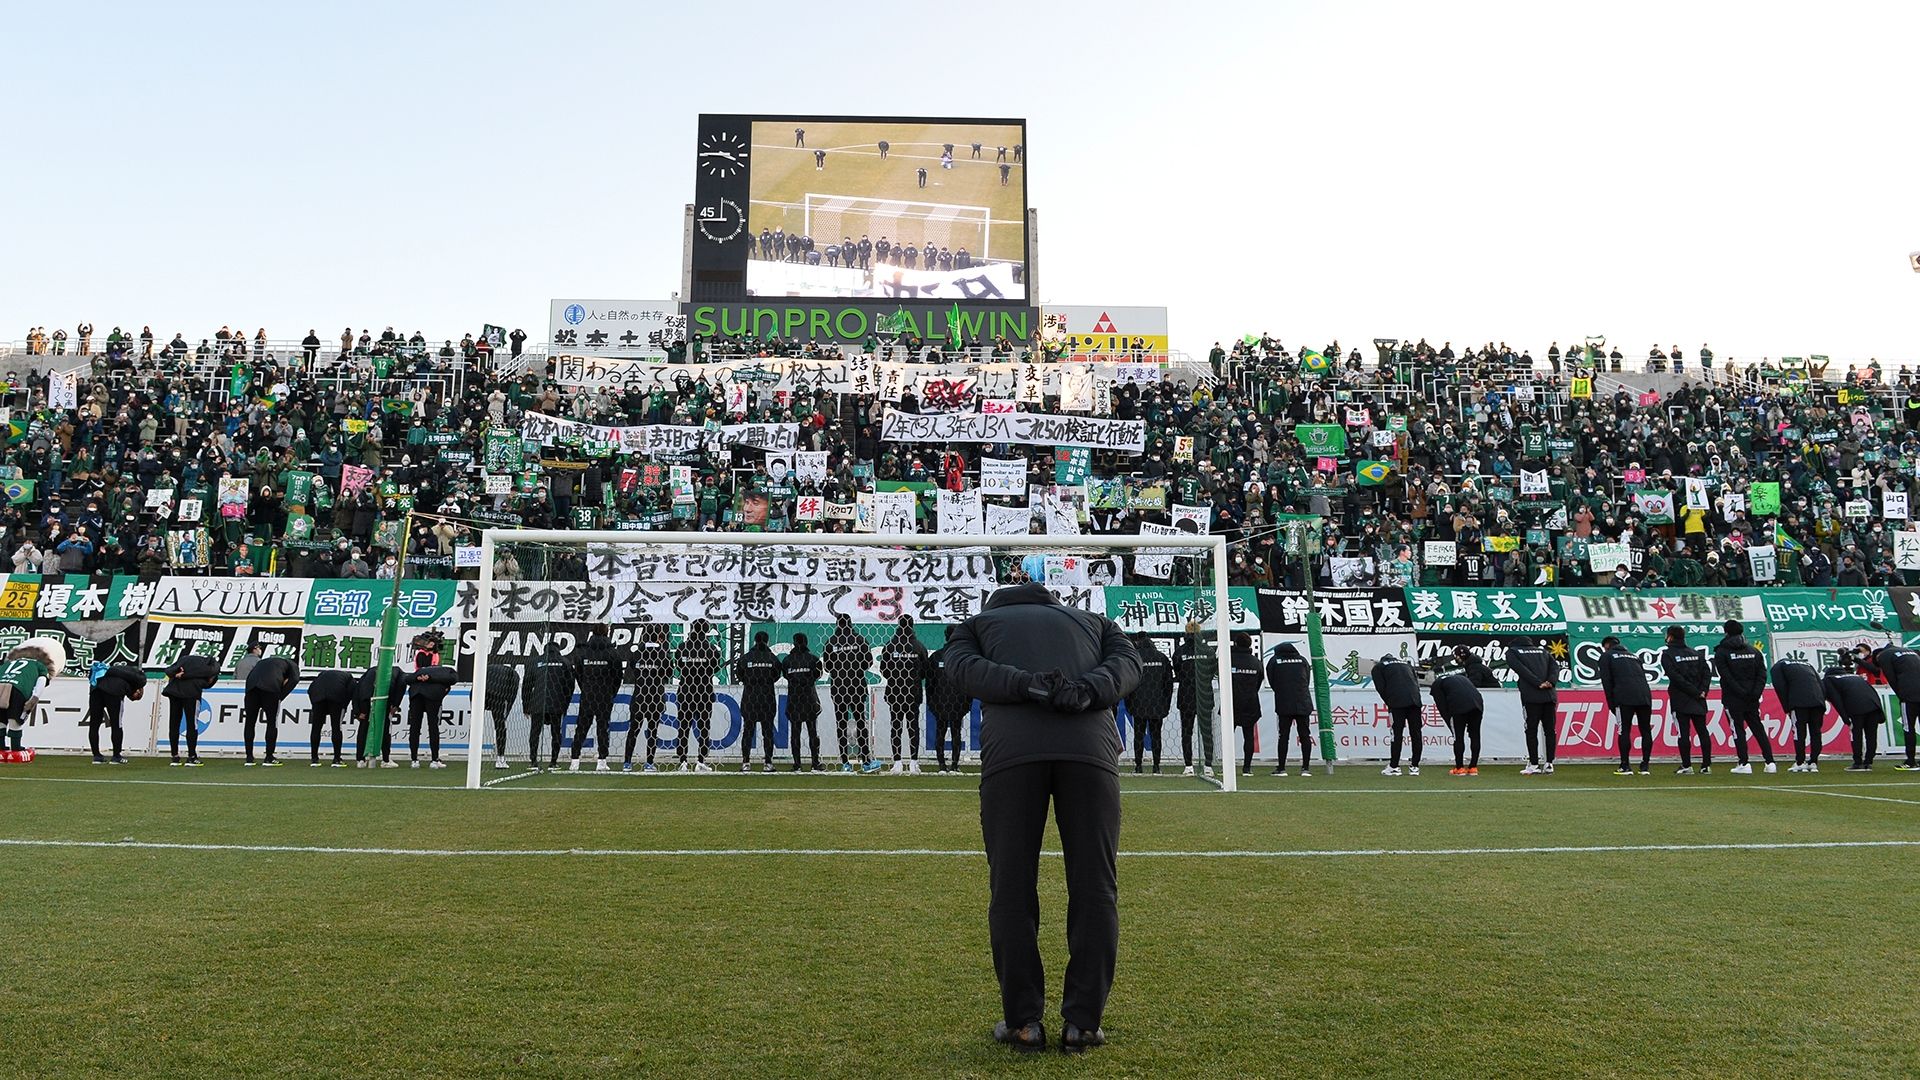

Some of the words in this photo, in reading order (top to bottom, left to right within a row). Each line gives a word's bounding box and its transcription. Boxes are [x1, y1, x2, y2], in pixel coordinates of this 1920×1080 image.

[700, 206, 715, 218] 45
[587, 310, 663, 322] 人と自然の共存
[664, 315, 686, 328] 名波
[899, 310, 1027, 341] ALWIN
[850, 355, 871, 393] 結果
[884, 370, 900, 398] 責任
[1023, 364, 1041, 401] 変革
[1529, 435, 1541, 445] 29
[983, 477, 996, 488] 10
[1016, 477, 1024, 488] 9
[1186, 481, 1192, 494] 3
[799, 497, 820, 519] 絆
[578, 509, 591, 522] 38
[734, 511, 743, 522] 13
[1153, 562, 1169, 577] 16
[191, 579, 281, 592] YOKOYAMA
[6, 591, 29, 608] 25
[156, 587, 304, 616] AYUMU
[1135, 592, 1164, 600] KANDA
[1411, 590, 1559, 620] 表原玄太
[1658, 601, 1669, 614] 3
[1281, 596, 1406, 628] 鈴木国友
[1766, 603, 1898, 623] 田中パウロ淳一
[348, 618, 370, 627] TAIKI
[439, 617, 452, 627] 37
[1447, 622, 1481, 631] Genta
[1492, 623, 1554, 632] Omotehara
[5, 660, 29, 675] 12
